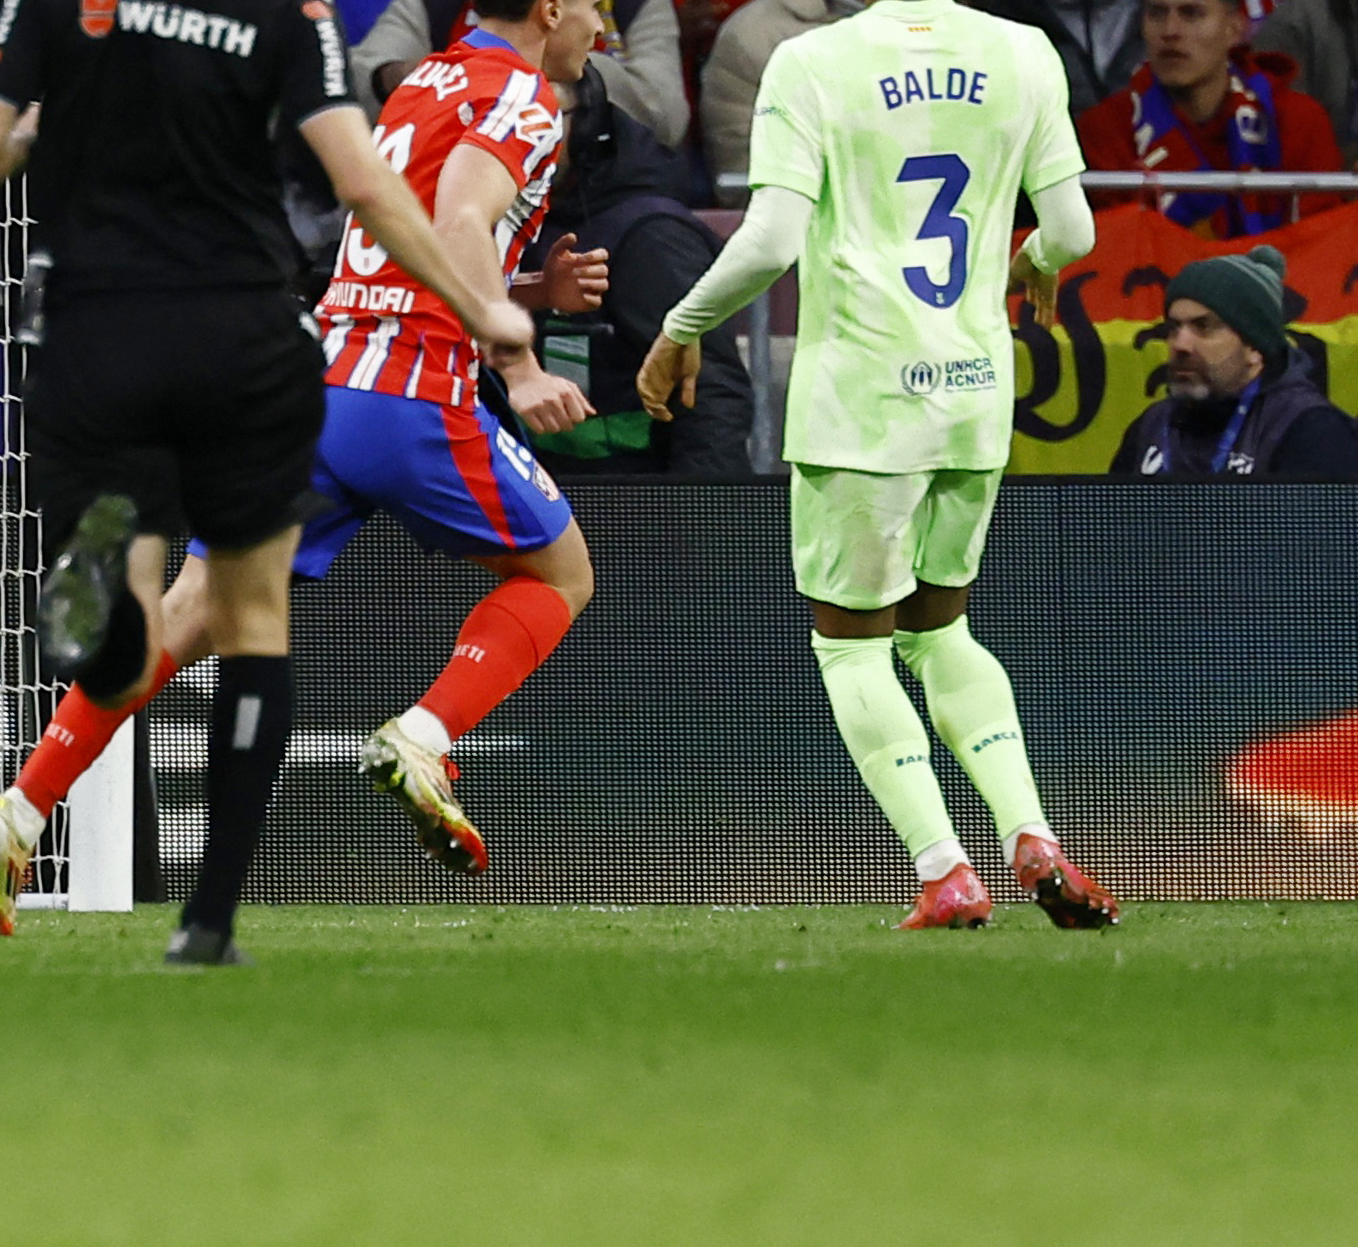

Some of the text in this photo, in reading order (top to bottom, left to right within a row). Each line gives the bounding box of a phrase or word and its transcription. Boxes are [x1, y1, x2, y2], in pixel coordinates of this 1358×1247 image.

[118, 0, 258, 57] WÜRTH
[879, 68, 987, 110] BALDE
[896, 153, 970, 309] 3
[945, 357, 993, 373] UNHCR
[945, 371, 996, 387] ACNUR
